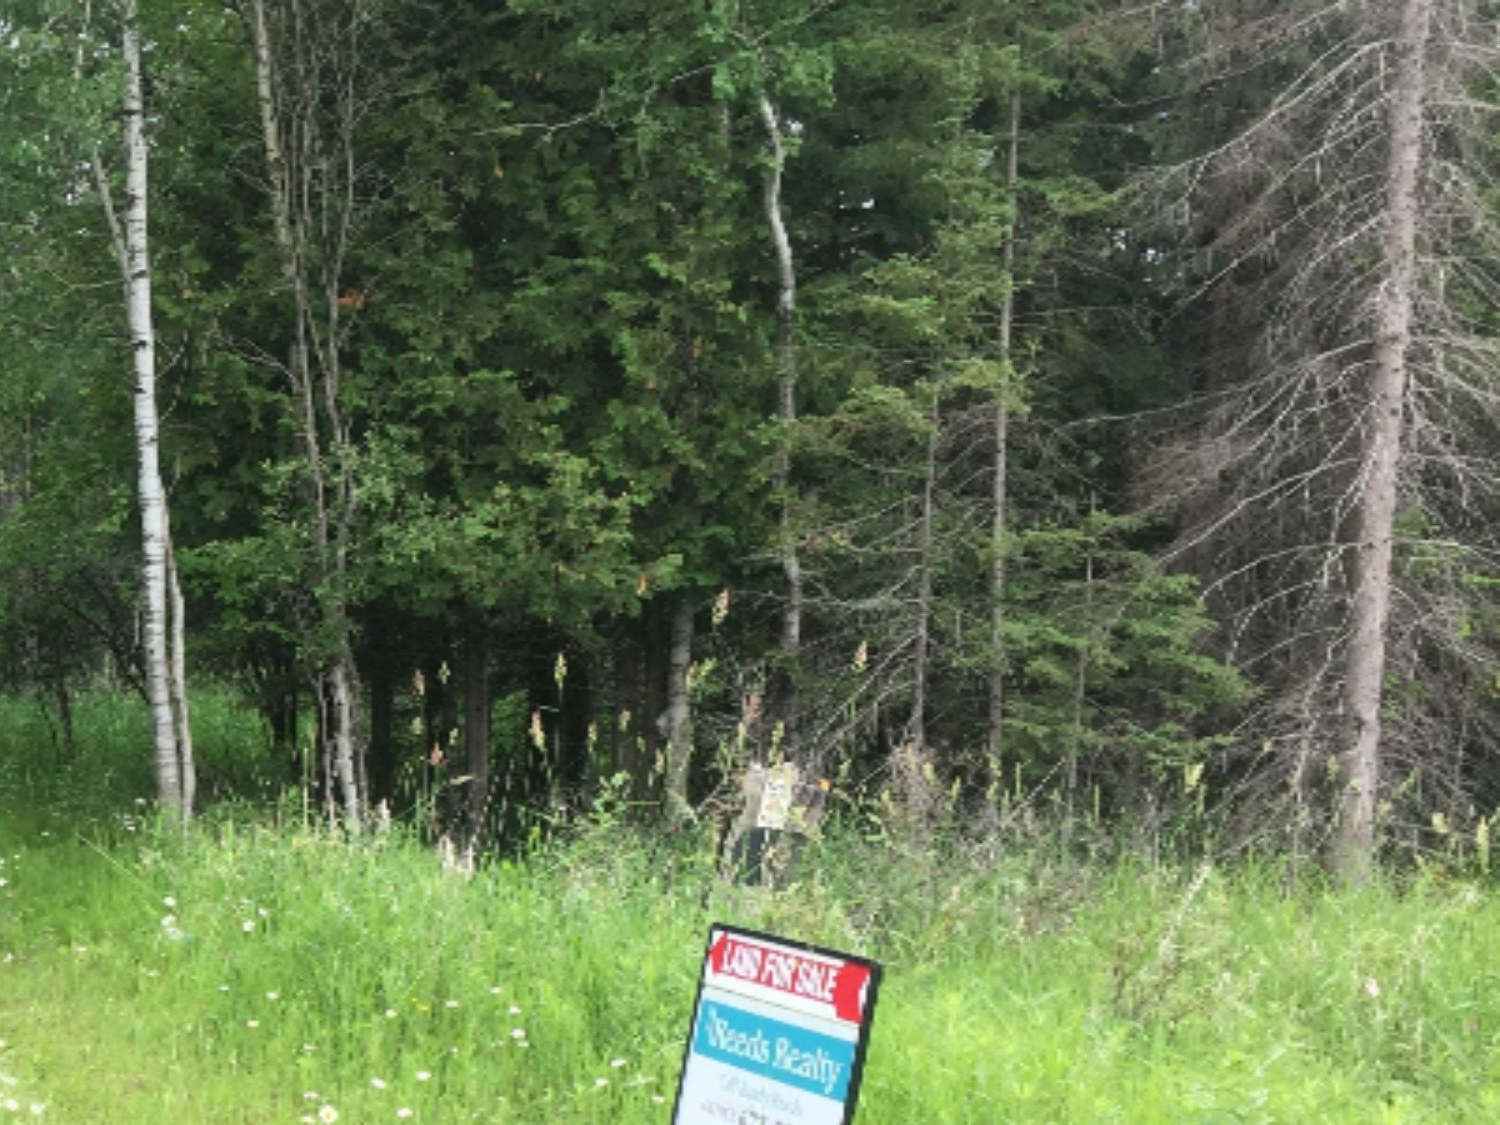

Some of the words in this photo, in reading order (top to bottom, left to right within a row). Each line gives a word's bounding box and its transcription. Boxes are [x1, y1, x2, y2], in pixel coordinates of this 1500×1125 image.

[721, 939, 762, 981] LAND
[760, 951, 797, 993] FOR
[794, 959, 838, 1003] SALE
[772, 1036, 844, 1095] Realty
